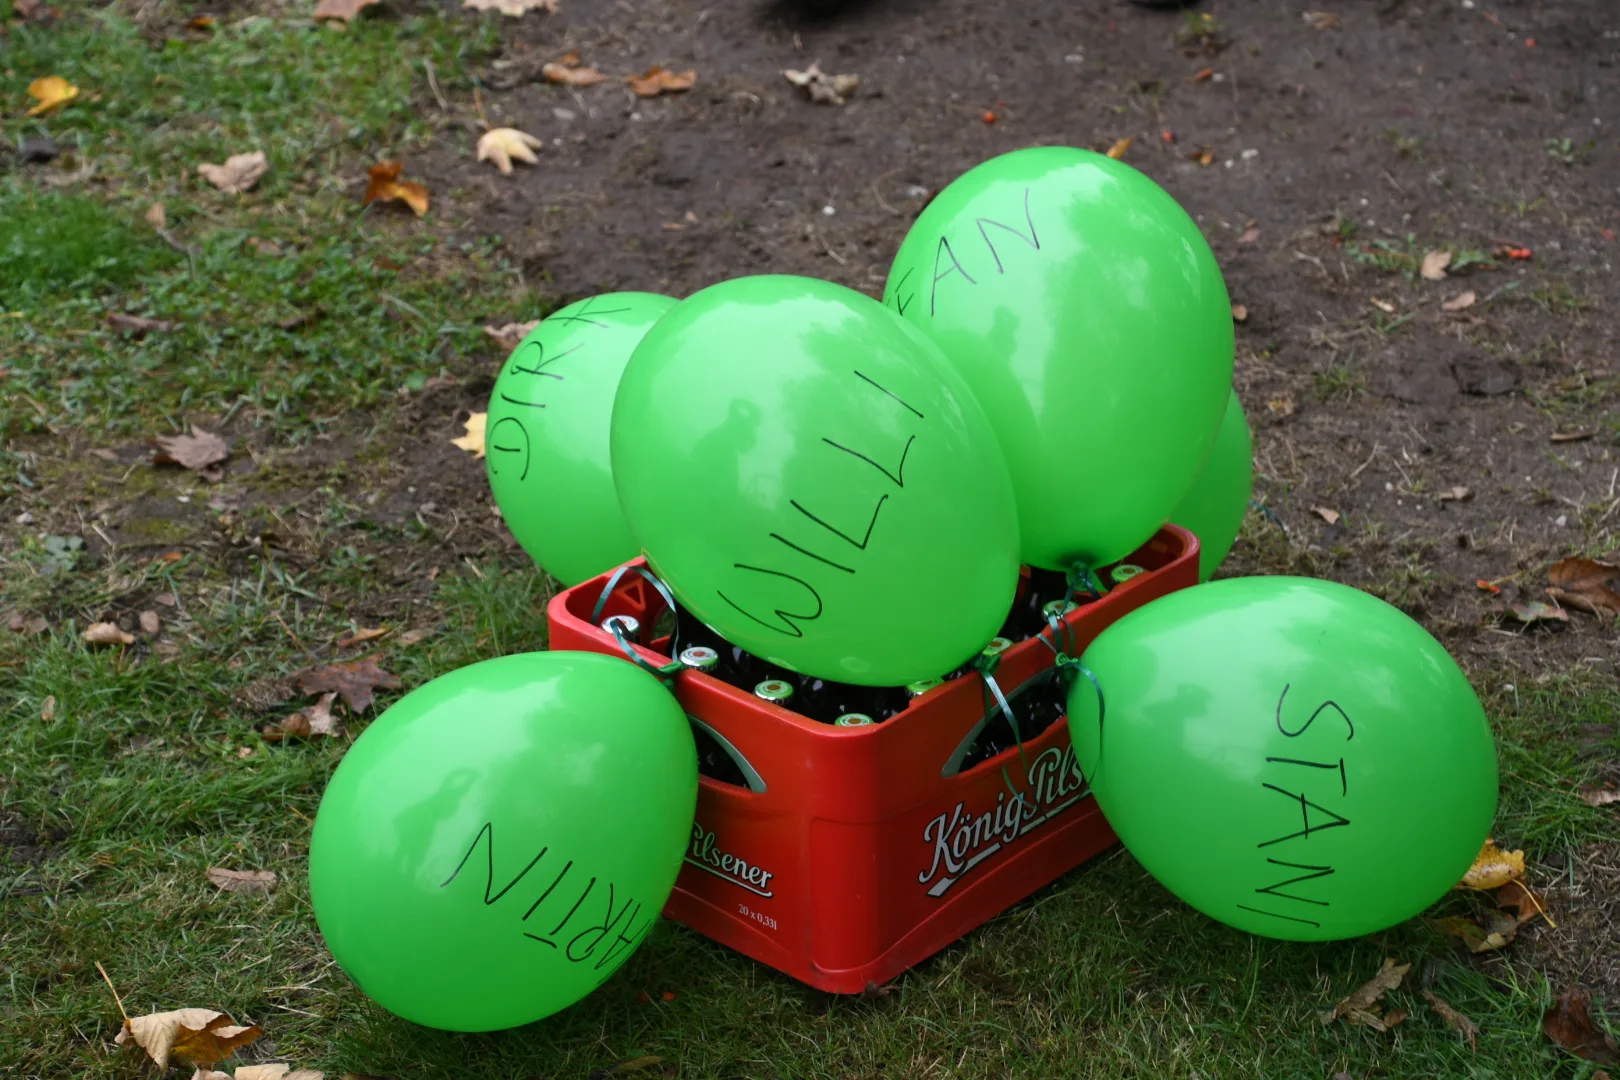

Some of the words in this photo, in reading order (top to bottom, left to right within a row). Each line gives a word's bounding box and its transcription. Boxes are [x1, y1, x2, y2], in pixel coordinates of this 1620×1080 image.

[886, 187, 1041, 318] FAN
[488, 295, 633, 482] DIRK
[716, 369, 925, 638] WILLI
[918, 791, 1025, 884] König
[1023, 741, 1084, 820] Pils
[1236, 682, 1355, 929] STANI
[439, 821, 653, 986] ARTIN
[738, 903, 749, 916] 20
